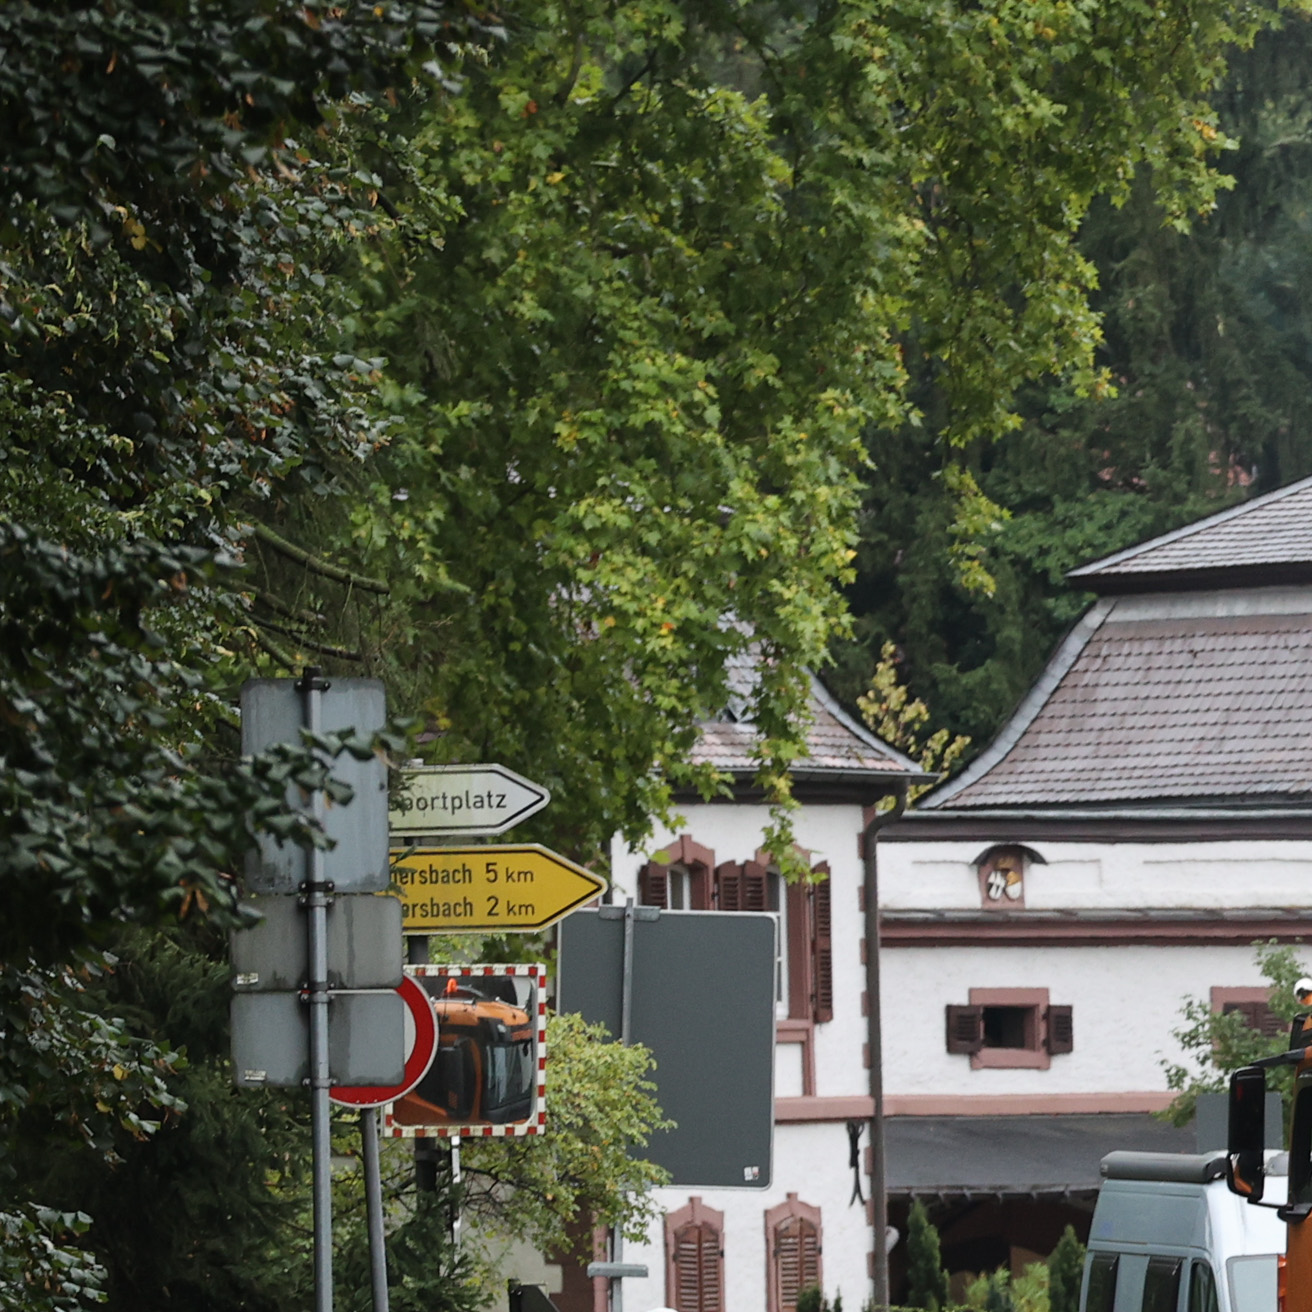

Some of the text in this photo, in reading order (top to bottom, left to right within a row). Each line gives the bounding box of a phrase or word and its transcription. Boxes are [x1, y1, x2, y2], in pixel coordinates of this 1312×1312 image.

[485, 862, 499, 883] 5
[505, 866, 534, 882] km
[486, 896, 499, 917] 2
[506, 900, 535, 916] km
